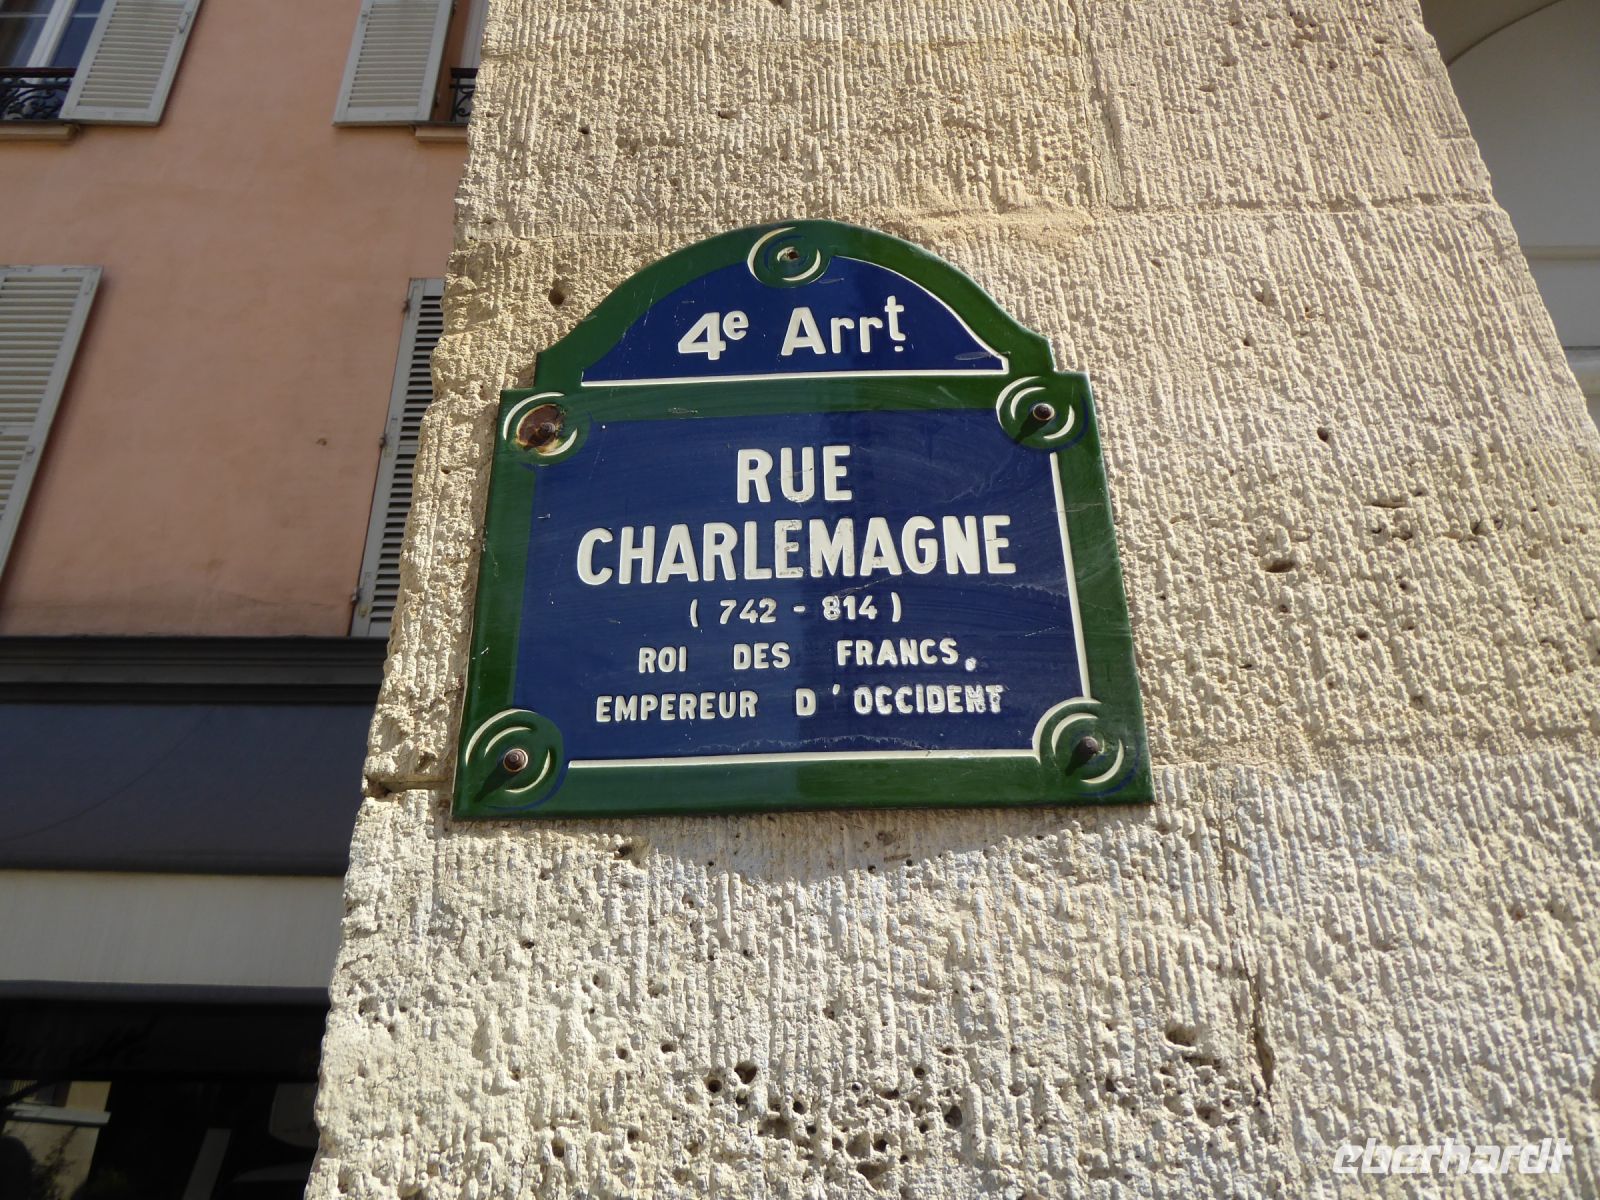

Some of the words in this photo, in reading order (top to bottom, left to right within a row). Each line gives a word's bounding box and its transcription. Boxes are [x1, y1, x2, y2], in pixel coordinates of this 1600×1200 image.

[677, 311, 748, 361] 4e
[736, 446, 852, 504] RUE
[576, 515, 1017, 586] CHARLEMAGNE
[638, 647, 687, 673] ROI
[733, 642, 791, 671] DES
[595, 691, 758, 723] EMPEREUR
